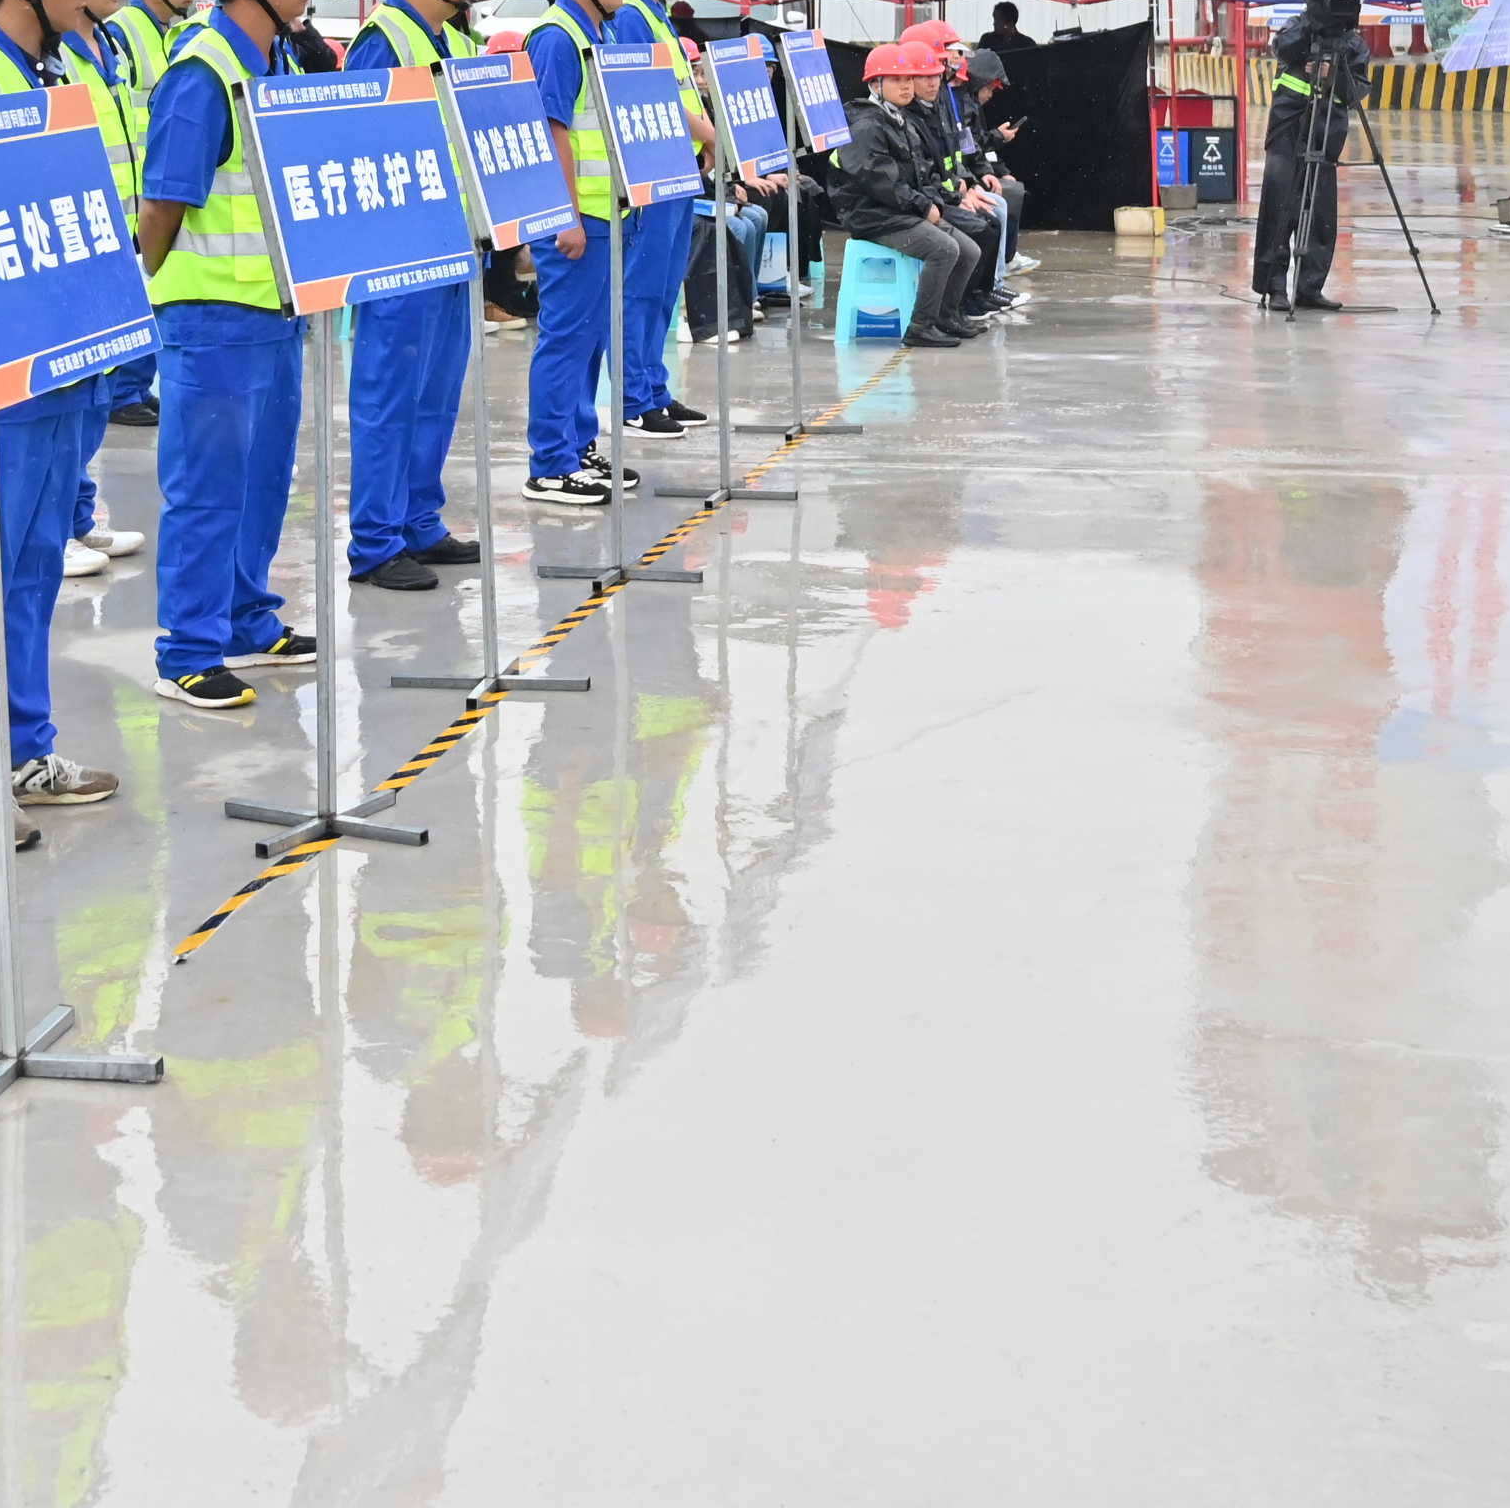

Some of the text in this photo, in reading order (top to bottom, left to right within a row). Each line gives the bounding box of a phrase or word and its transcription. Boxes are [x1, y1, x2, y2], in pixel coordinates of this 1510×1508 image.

[473, 120, 553, 176] 抢险救援组
[616, 101, 686, 144] 技术保障组
[282, 148, 447, 221] 医疗救护组
